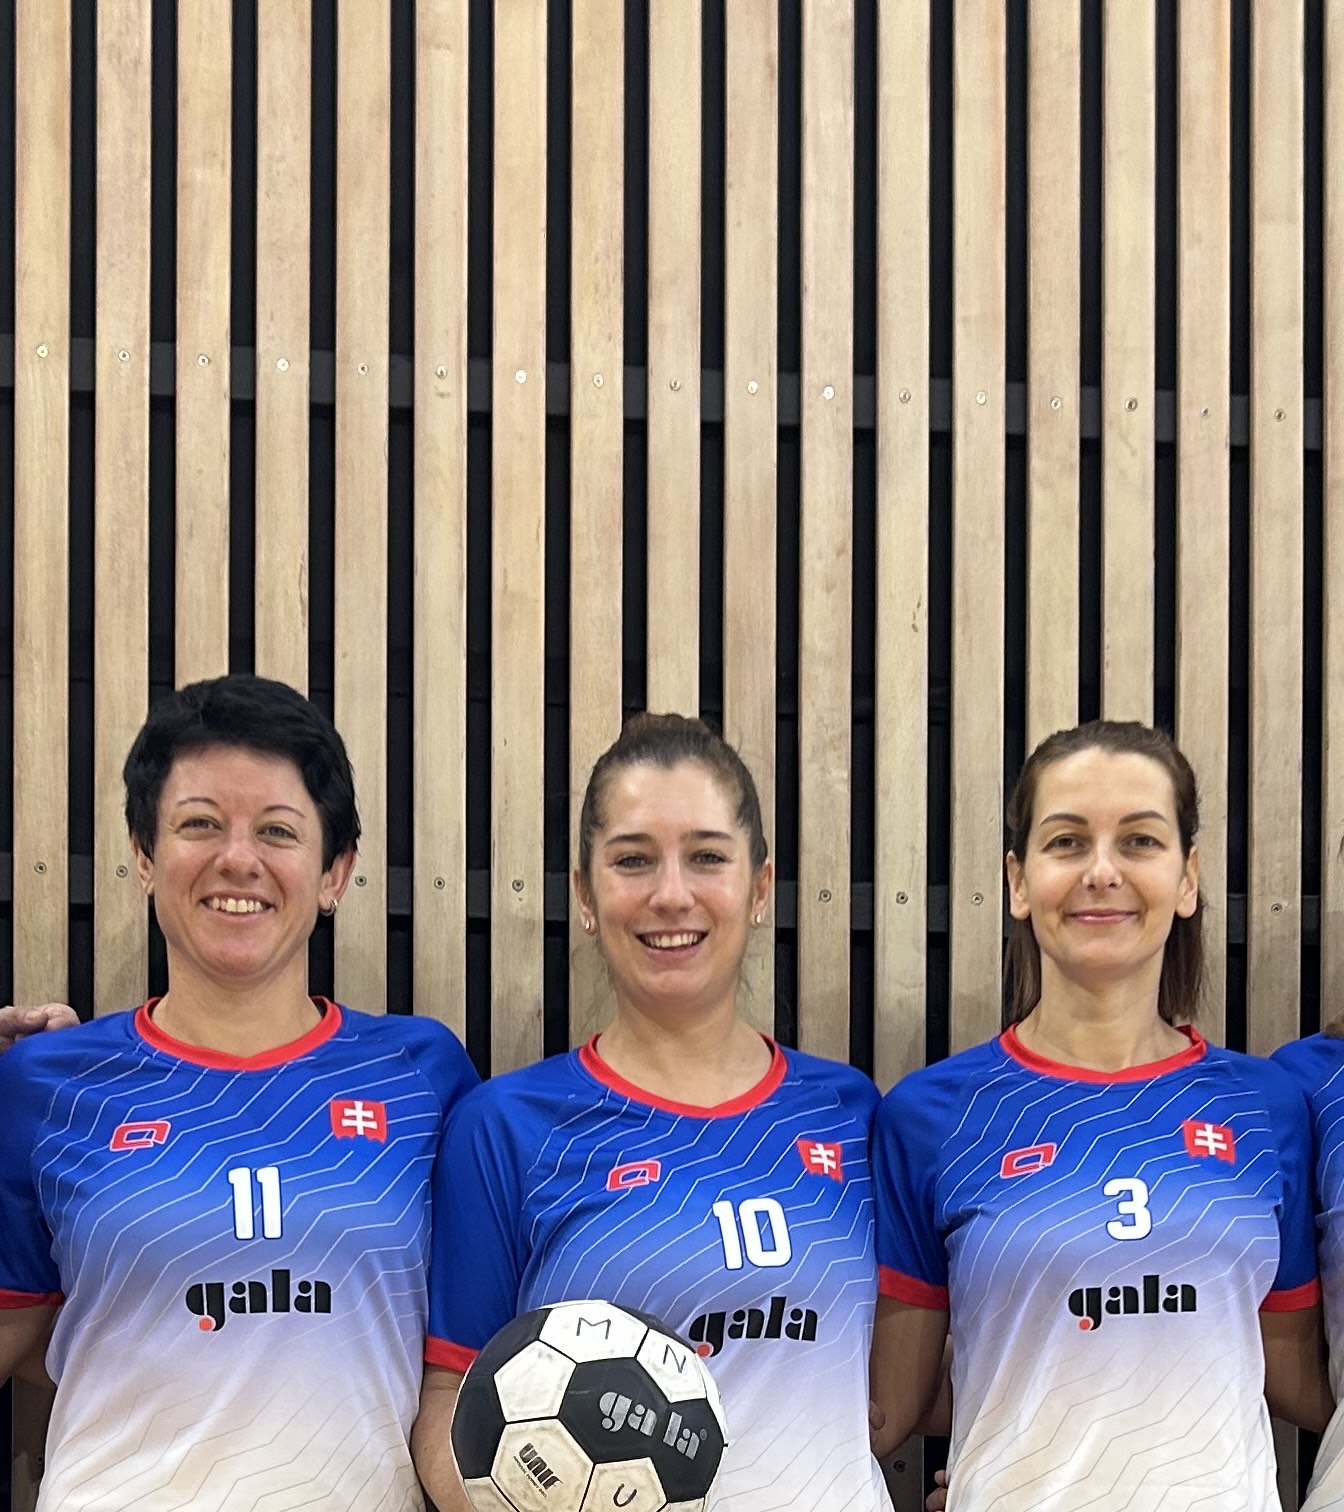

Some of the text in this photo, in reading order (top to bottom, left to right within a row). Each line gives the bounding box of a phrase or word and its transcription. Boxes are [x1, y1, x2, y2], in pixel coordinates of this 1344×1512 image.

[228, 1166, 283, 1240] 11
[713, 1198, 792, 1270] 10
[1103, 1177, 1152, 1241] 3
[185, 1269, 332, 1332] gala
[576, 1317, 612, 1341] M
[688, 1297, 818, 1358] gala
[1068, 1274, 1197, 1330] gala
[599, 1391, 701, 1460] gala
